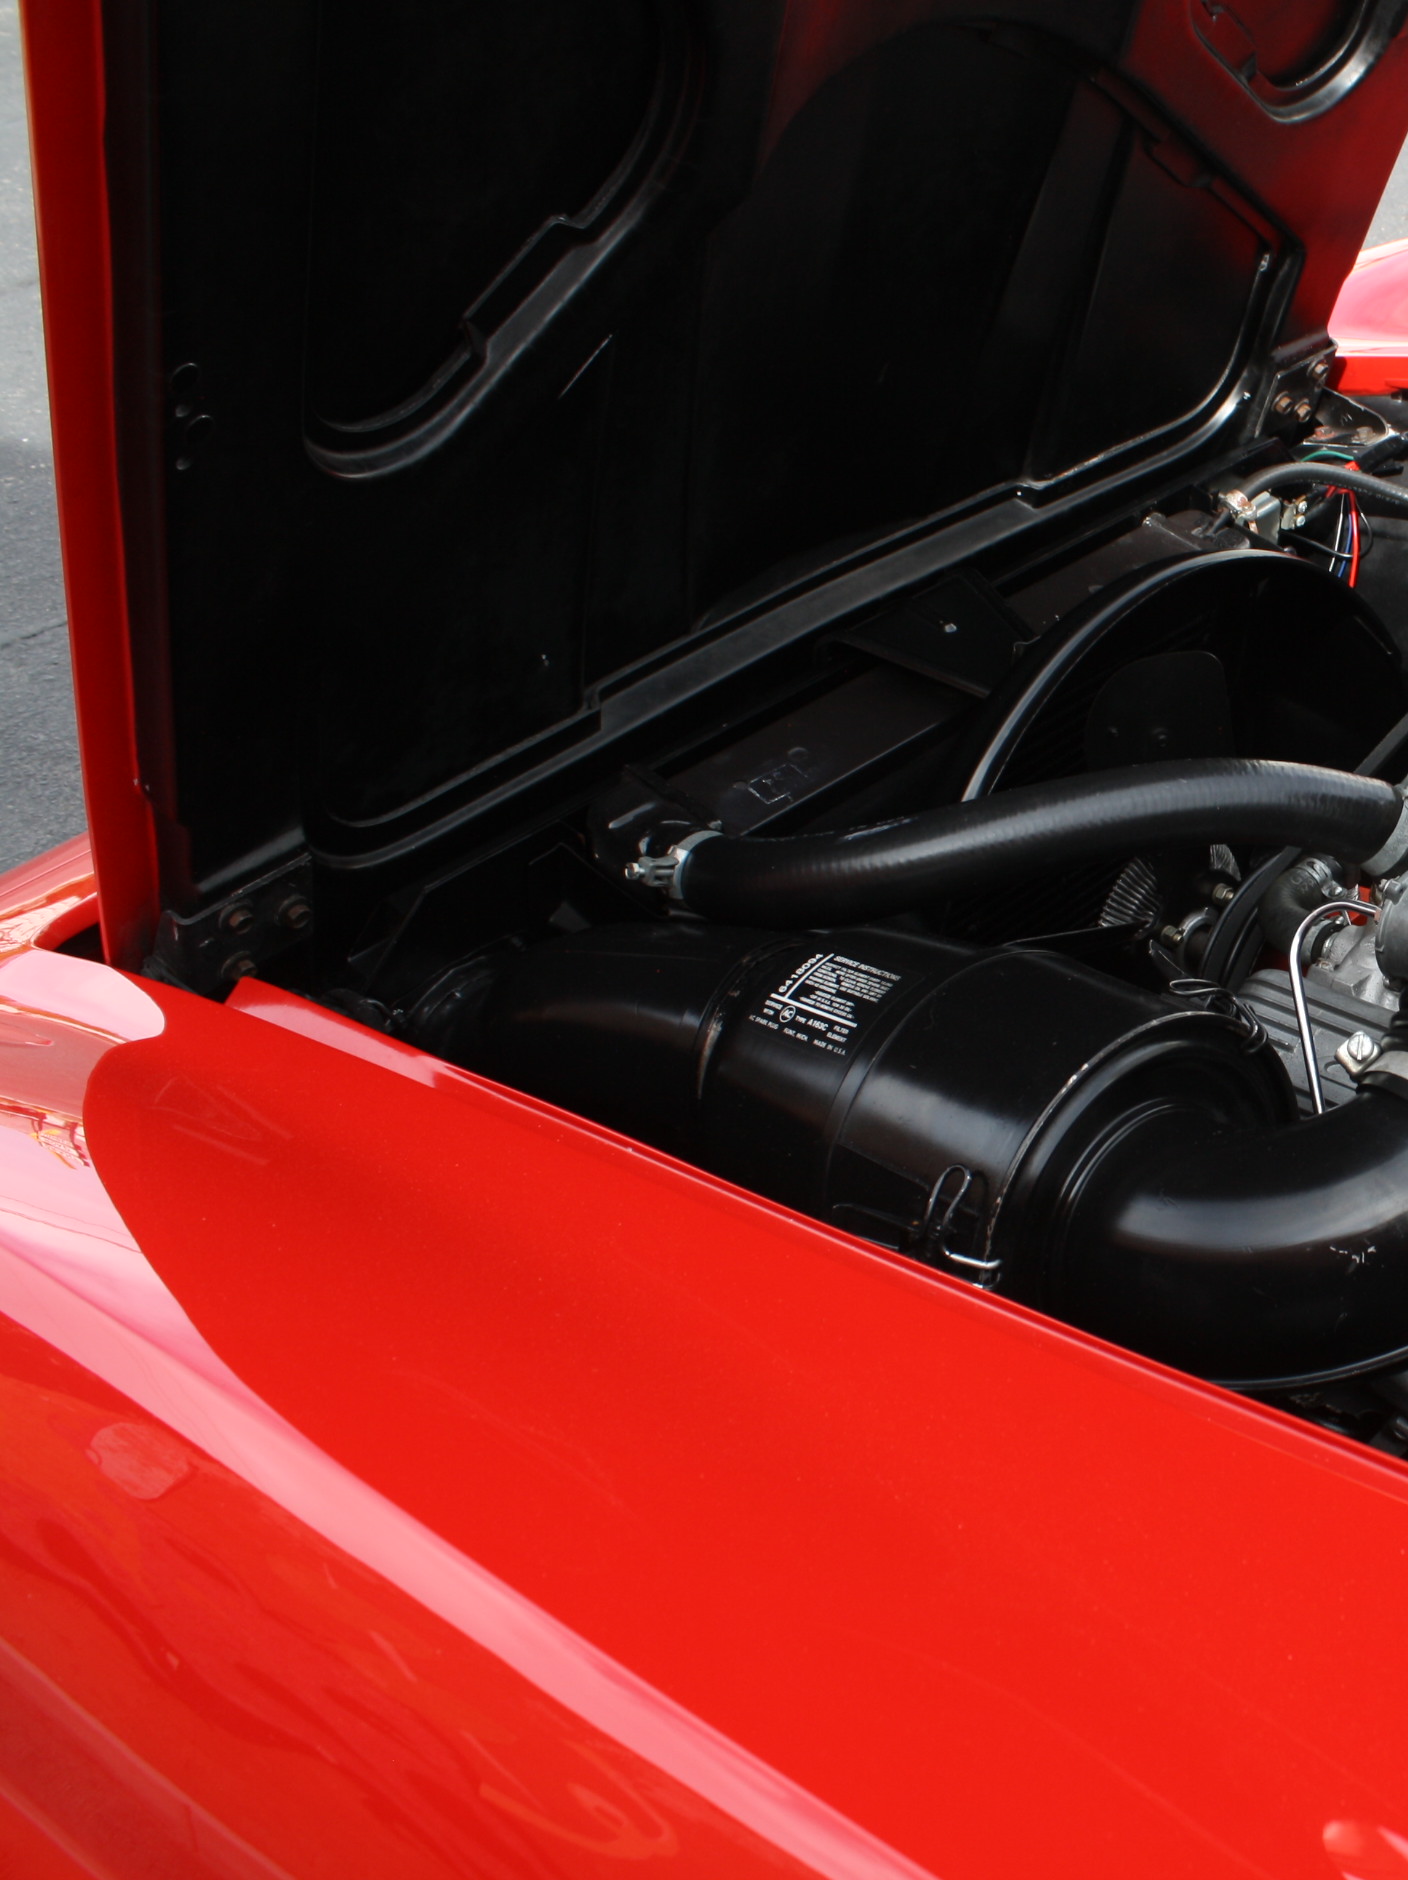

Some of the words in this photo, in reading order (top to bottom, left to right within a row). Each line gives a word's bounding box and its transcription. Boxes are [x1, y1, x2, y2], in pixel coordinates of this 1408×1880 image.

[833, 956, 860, 968] SERVICE
[859, 964, 901, 981] INSTRUCTIONS
[765, 1000, 783, 1010] SERVICE
[795, 1016, 807, 1024] TYPE
[807, 1019, 829, 1031] A163C
[833, 1025, 849, 1034] FILTER
[756, 1017, 769, 1025] SPARK
[768, 1021, 780, 1029] PLUG
[813, 1039, 827, 1048] MADE
[827, 1032, 847, 1042] ELEMENT
